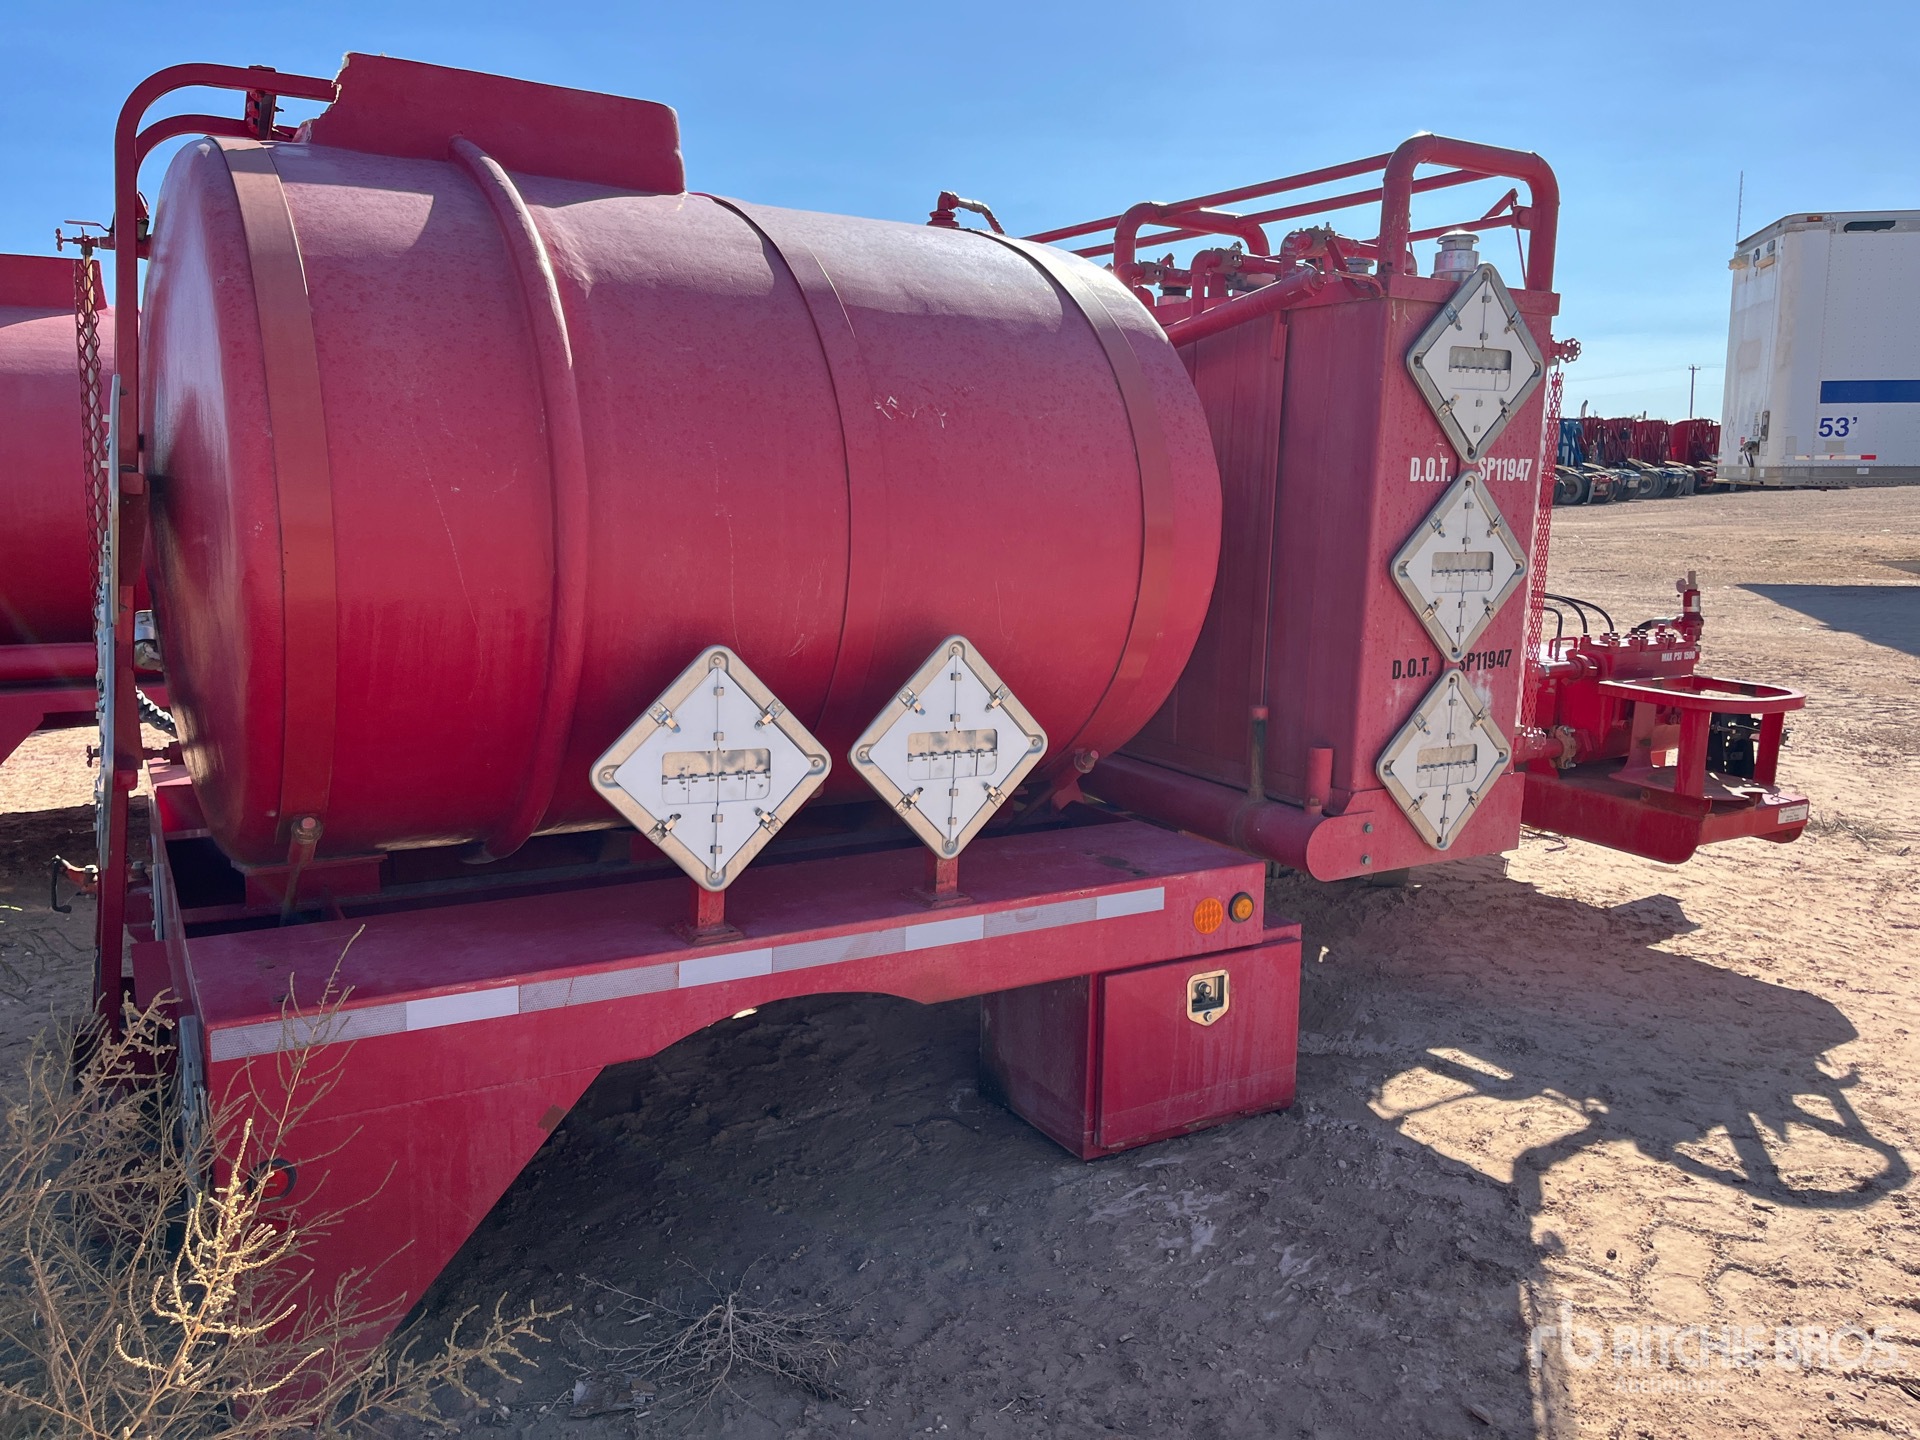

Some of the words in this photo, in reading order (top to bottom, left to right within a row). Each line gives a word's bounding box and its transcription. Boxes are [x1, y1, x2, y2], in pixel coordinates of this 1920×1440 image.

[1818, 416, 1858, 438] 53'
[1409, 457, 1452, 482] D.O.T.
[1477, 457, 1533, 482] SP11947
[1391, 657, 1433, 680] D.O.T.
[1458, 649, 1513, 672] SP11947
